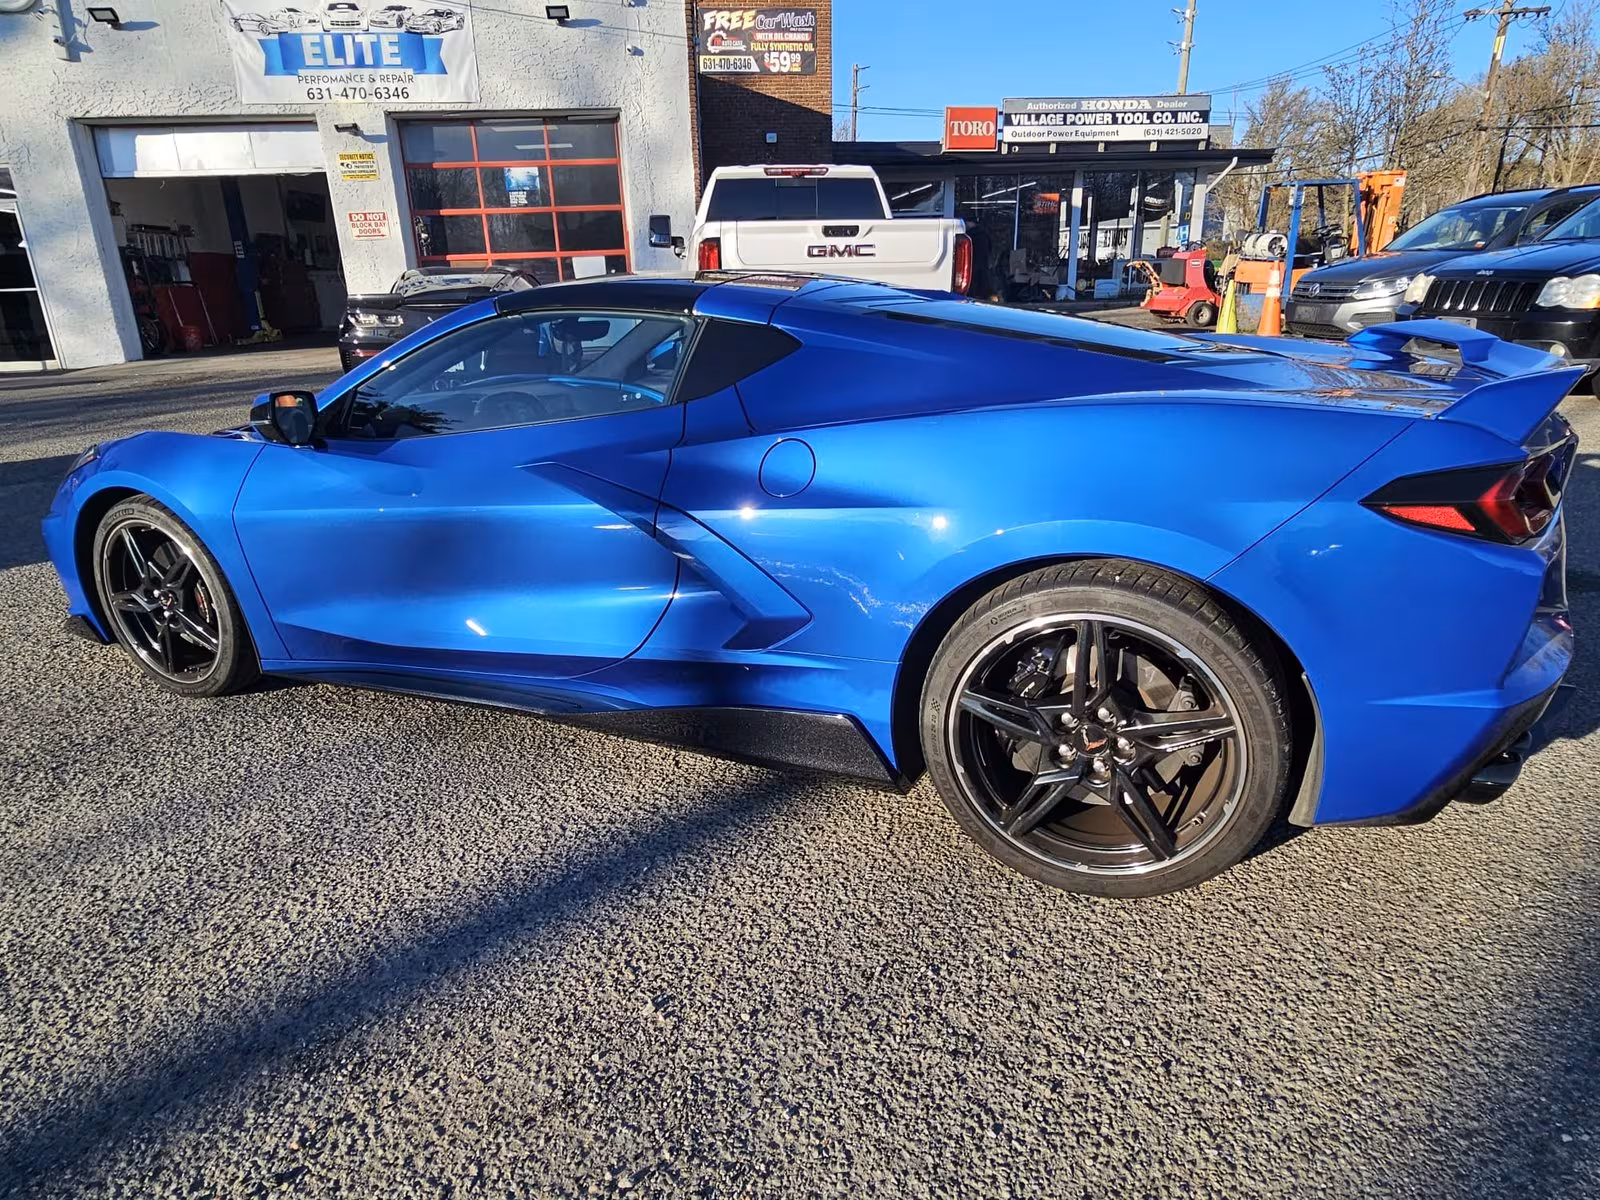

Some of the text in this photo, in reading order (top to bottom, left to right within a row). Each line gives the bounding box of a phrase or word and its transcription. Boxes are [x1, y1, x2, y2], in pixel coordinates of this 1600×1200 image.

[703, 10, 815, 30] FREE Car Wash
[756, 32, 809, 41] WITH OIL CHANGE
[301, 34, 402, 66] ELITE
[751, 42, 815, 51] FULLY SYNTHETIC OIL
[703, 57, 752, 70] 631-470-6346
[298, 72, 414, 84] PERFOMANCE & REPAIR
[306, 87, 410, 100] 631-470-6346
[1027, 100, 1188, 110] Authorized HONDA Dealer
[1011, 111, 1203, 125] VILLAGE POWER TOOL CO. INC.
[950, 120, 995, 136] TORO
[1011, 127, 1202, 139] Outdoor Power Equipment (631) 421-5020
[351, 212, 385, 221] DO NOT
[807, 244, 876, 257] GMC
